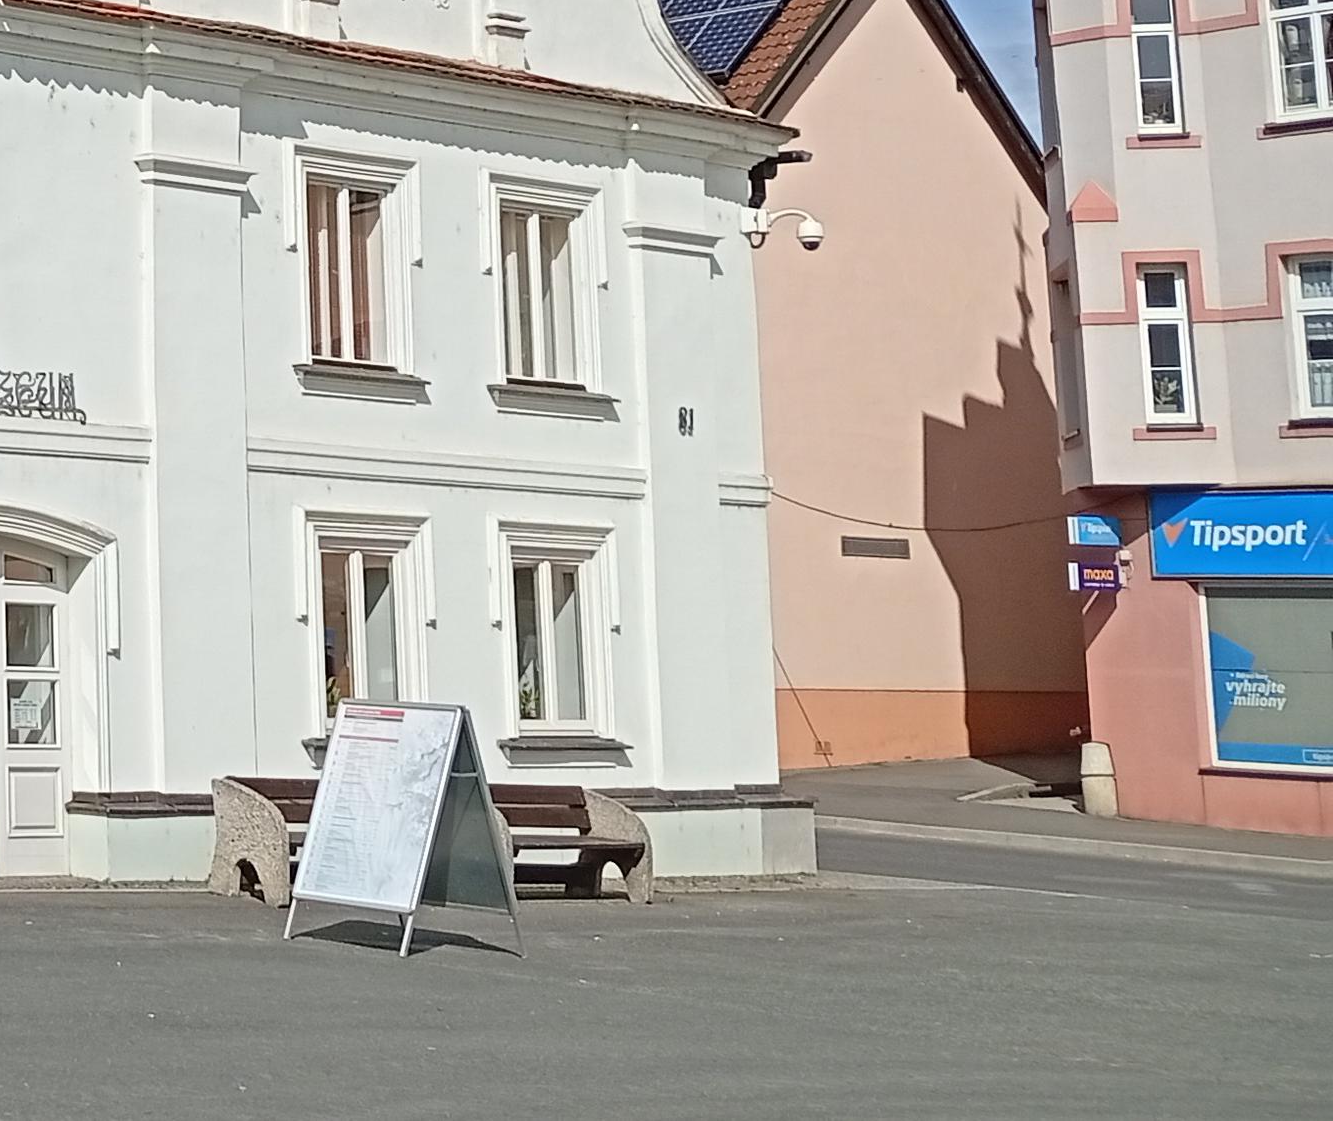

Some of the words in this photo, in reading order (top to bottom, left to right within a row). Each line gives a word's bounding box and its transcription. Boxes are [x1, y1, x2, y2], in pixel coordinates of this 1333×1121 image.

[1190, 519, 1307, 552] Tipsport
[1084, 569, 1114, 580] maxa
[1225, 680, 1286, 696] vyhrajte
[1233, 693, 1287, 711] miliony
